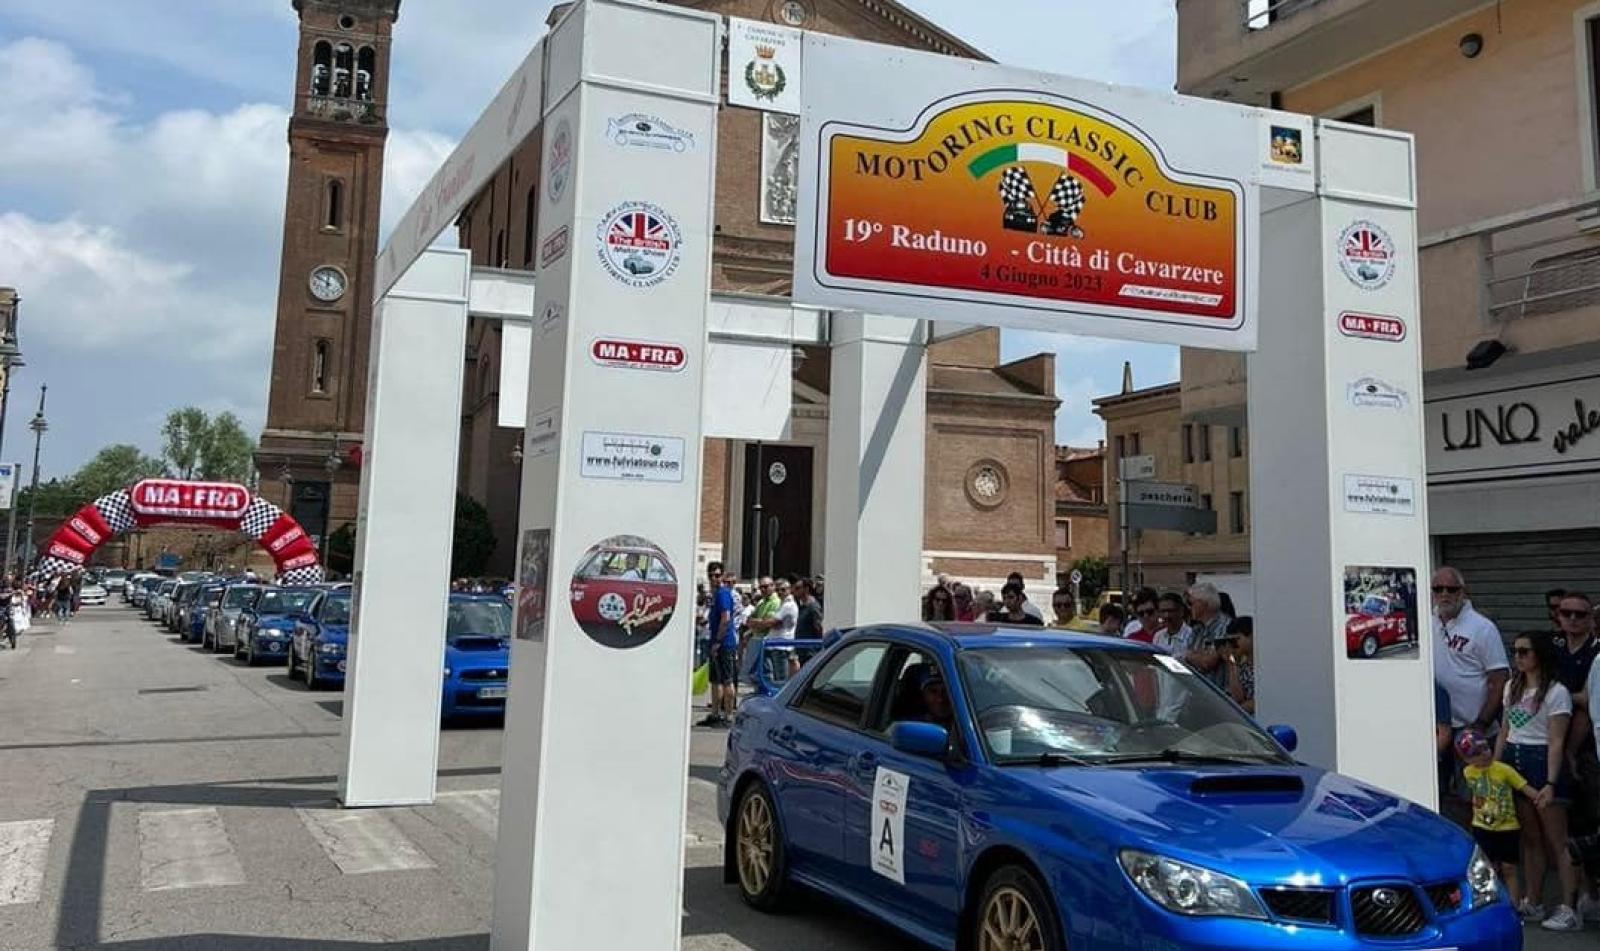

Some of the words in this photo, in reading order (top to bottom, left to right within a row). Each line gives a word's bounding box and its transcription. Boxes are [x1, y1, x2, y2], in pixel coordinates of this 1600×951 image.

[855, 114, 1014, 181] MOTORING
[1025, 115, 1145, 189] CLASSIC
[1144, 189, 1218, 221] CLUB
[891, 224, 987, 257] Raduno
[1027, 240, 1082, 268] Città
[1089, 248, 1110, 272] di
[1117, 251, 1225, 284] Cavarzere
[981, 263, 991, 279] 4
[996, 264, 1059, 289] Giugno
[1062, 270, 1103, 290] 2023
[880, 817, 894, 856] A
